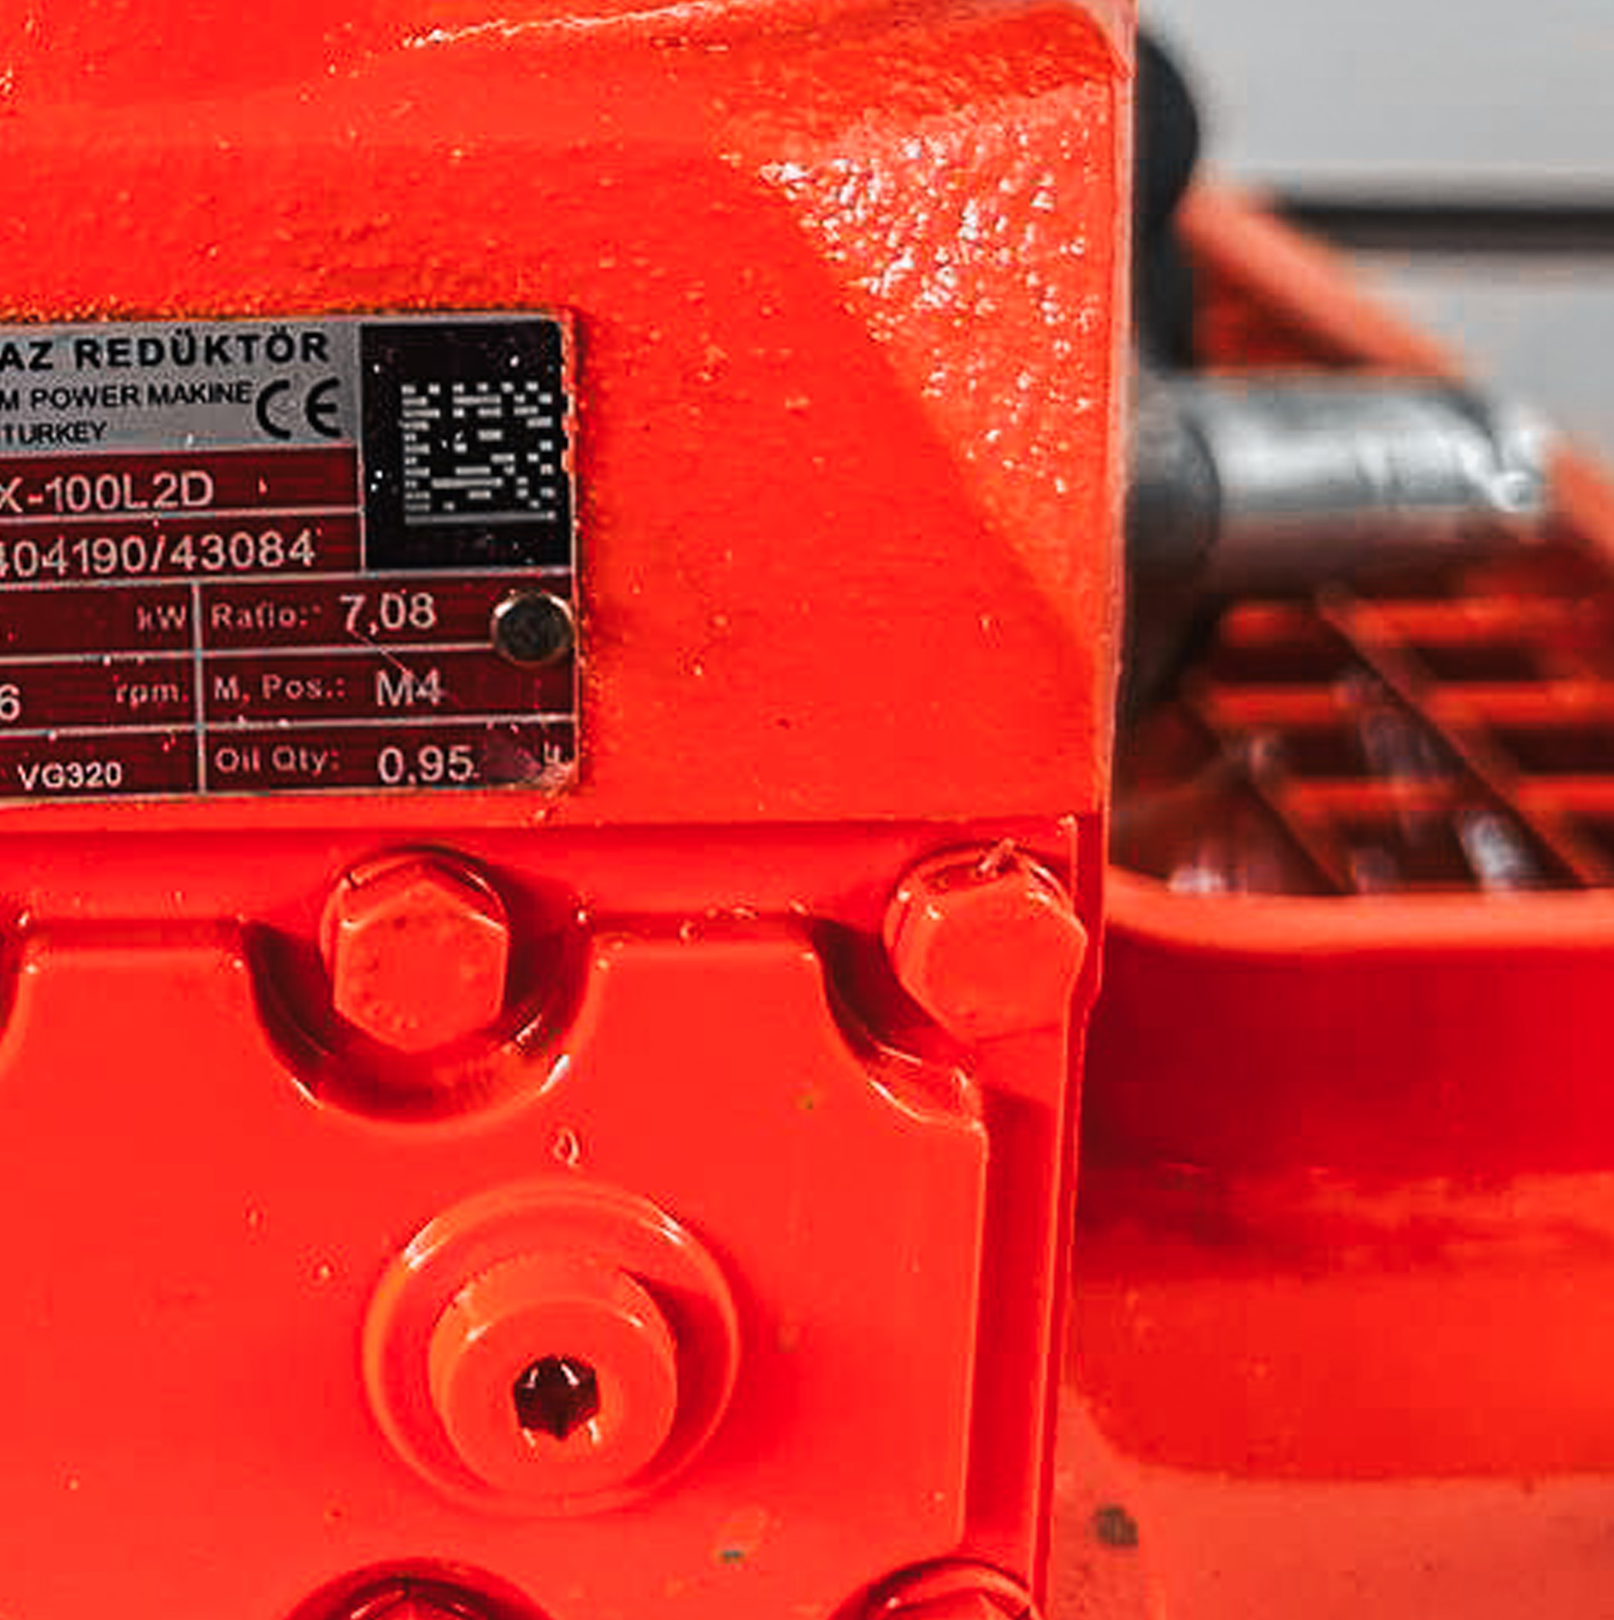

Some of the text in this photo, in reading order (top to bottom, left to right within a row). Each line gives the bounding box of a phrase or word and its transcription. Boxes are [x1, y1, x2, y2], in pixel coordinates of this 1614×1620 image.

[73, 326, 330, 369] REDÜKTÖR
[30, 384, 141, 410] POWER
[146, 380, 253, 405] MAKINE
[3, 421, 107, 446] TURKEY
[137, 604, 187, 631] kW
[339, 592, 437, 636] 7,08
[376, 668, 442, 707] M4
[17, 760, 124, 791] VG320
[214, 746, 261, 773] Oil
[272, 745, 340, 777] Qty:
